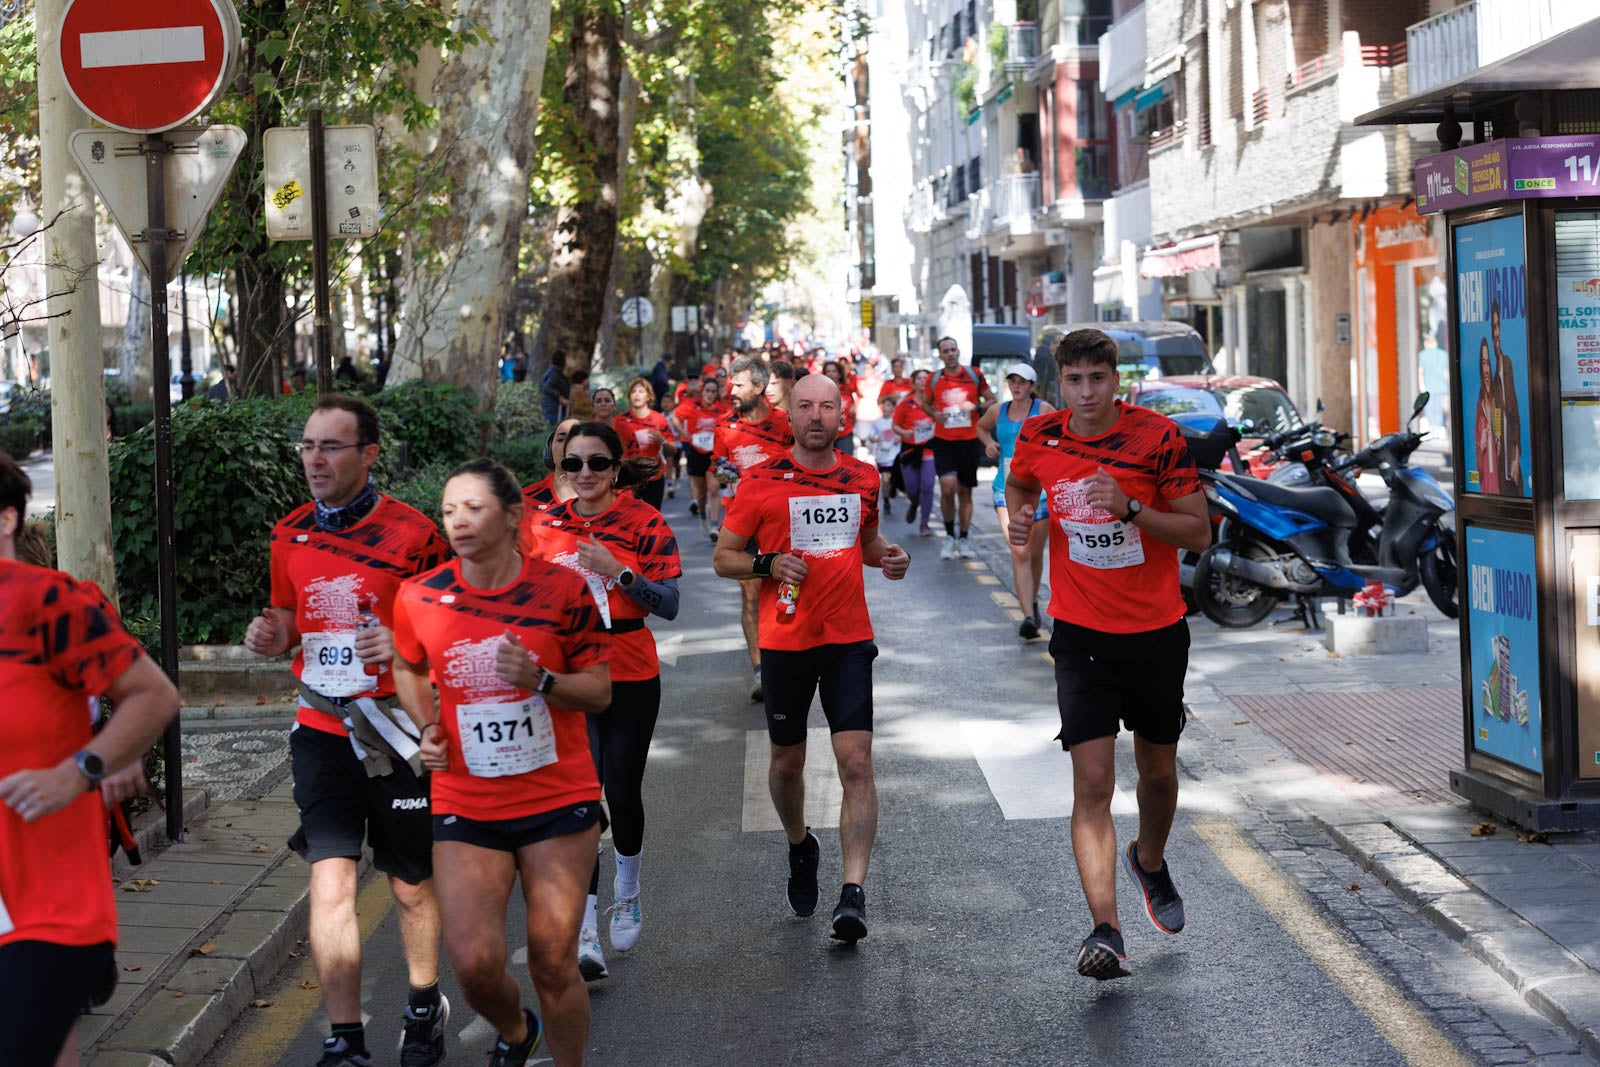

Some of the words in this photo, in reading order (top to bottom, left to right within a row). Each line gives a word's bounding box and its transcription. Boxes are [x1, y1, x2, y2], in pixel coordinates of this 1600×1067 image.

[1526, 180, 1553, 188] ONCE
[1460, 270, 1482, 324] BIEN
[1558, 306, 1573, 317] EL
[1558, 316, 1588, 329] MÁS
[1590, 318, 1600, 329] T
[802, 507, 849, 525] 1623
[1471, 564, 1494, 613] BIEN
[1495, 568, 1532, 621] JUGADO
[319, 646, 353, 666] 699
[473, 716, 534, 743] 1371
[392, 797, 428, 810] PUMA
